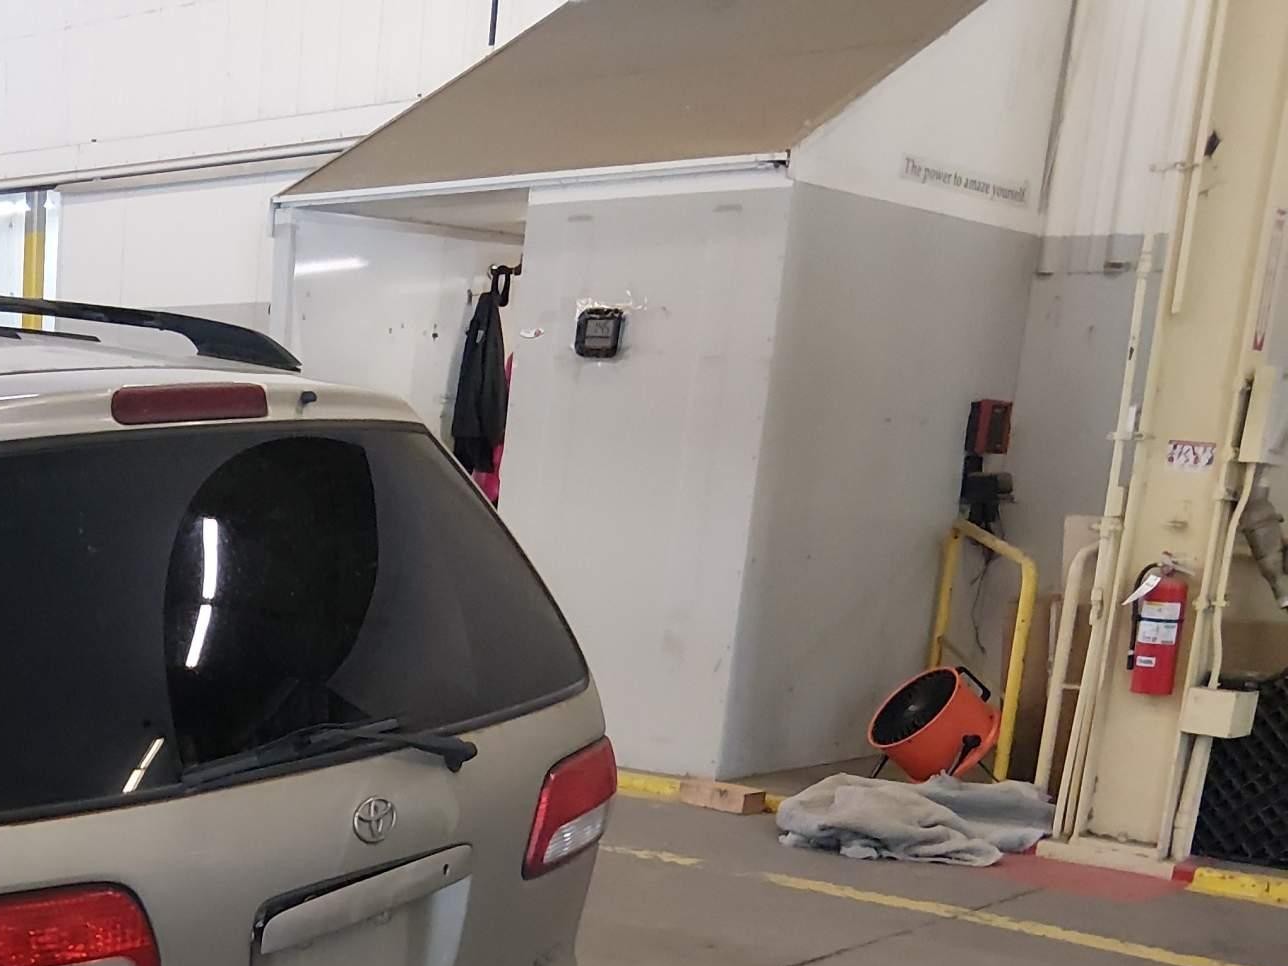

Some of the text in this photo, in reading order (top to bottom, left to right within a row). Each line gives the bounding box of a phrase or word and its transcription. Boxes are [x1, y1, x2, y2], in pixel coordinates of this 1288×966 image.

[904, 157, 922, 177] The
[921, 167, 952, 185] power
[952, 171, 963, 187] to
[963, 177, 991, 195] amaze
